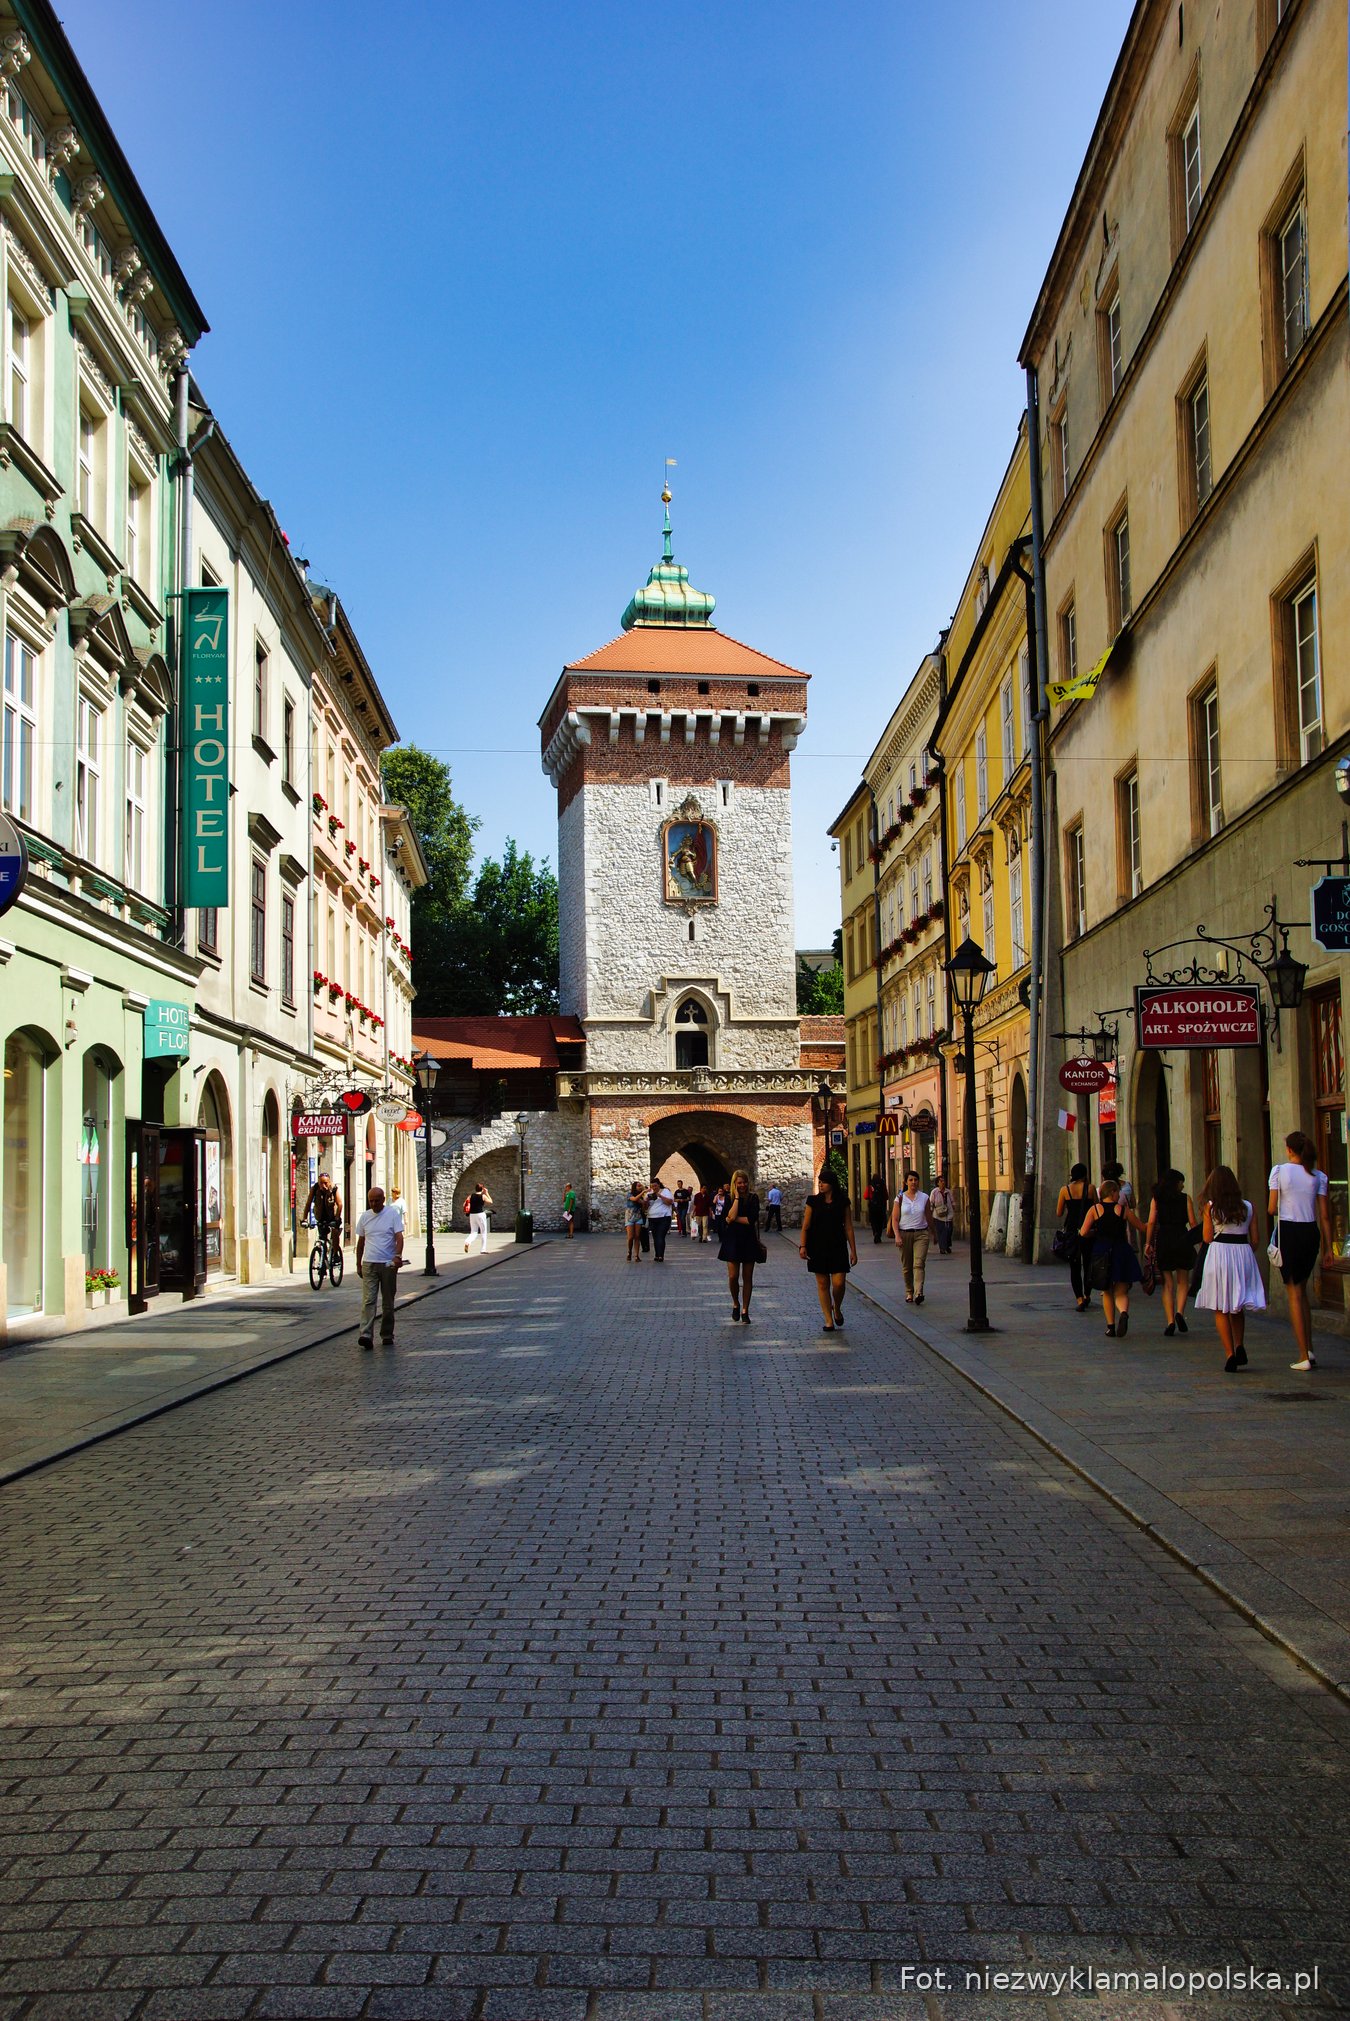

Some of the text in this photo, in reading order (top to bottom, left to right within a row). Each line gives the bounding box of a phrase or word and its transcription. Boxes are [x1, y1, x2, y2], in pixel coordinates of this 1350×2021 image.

[194, 703, 225, 873] HOTEL
[1149, 1000, 1248, 1014] ALKOHOLE
[1144, 1021, 1256, 1034] ART. SPOŻYWCZE
[1064, 1070, 1105, 1079] KANTOR
[298, 1115, 343, 1126] KANTOR
[297, 1125, 344, 1135] exchange
